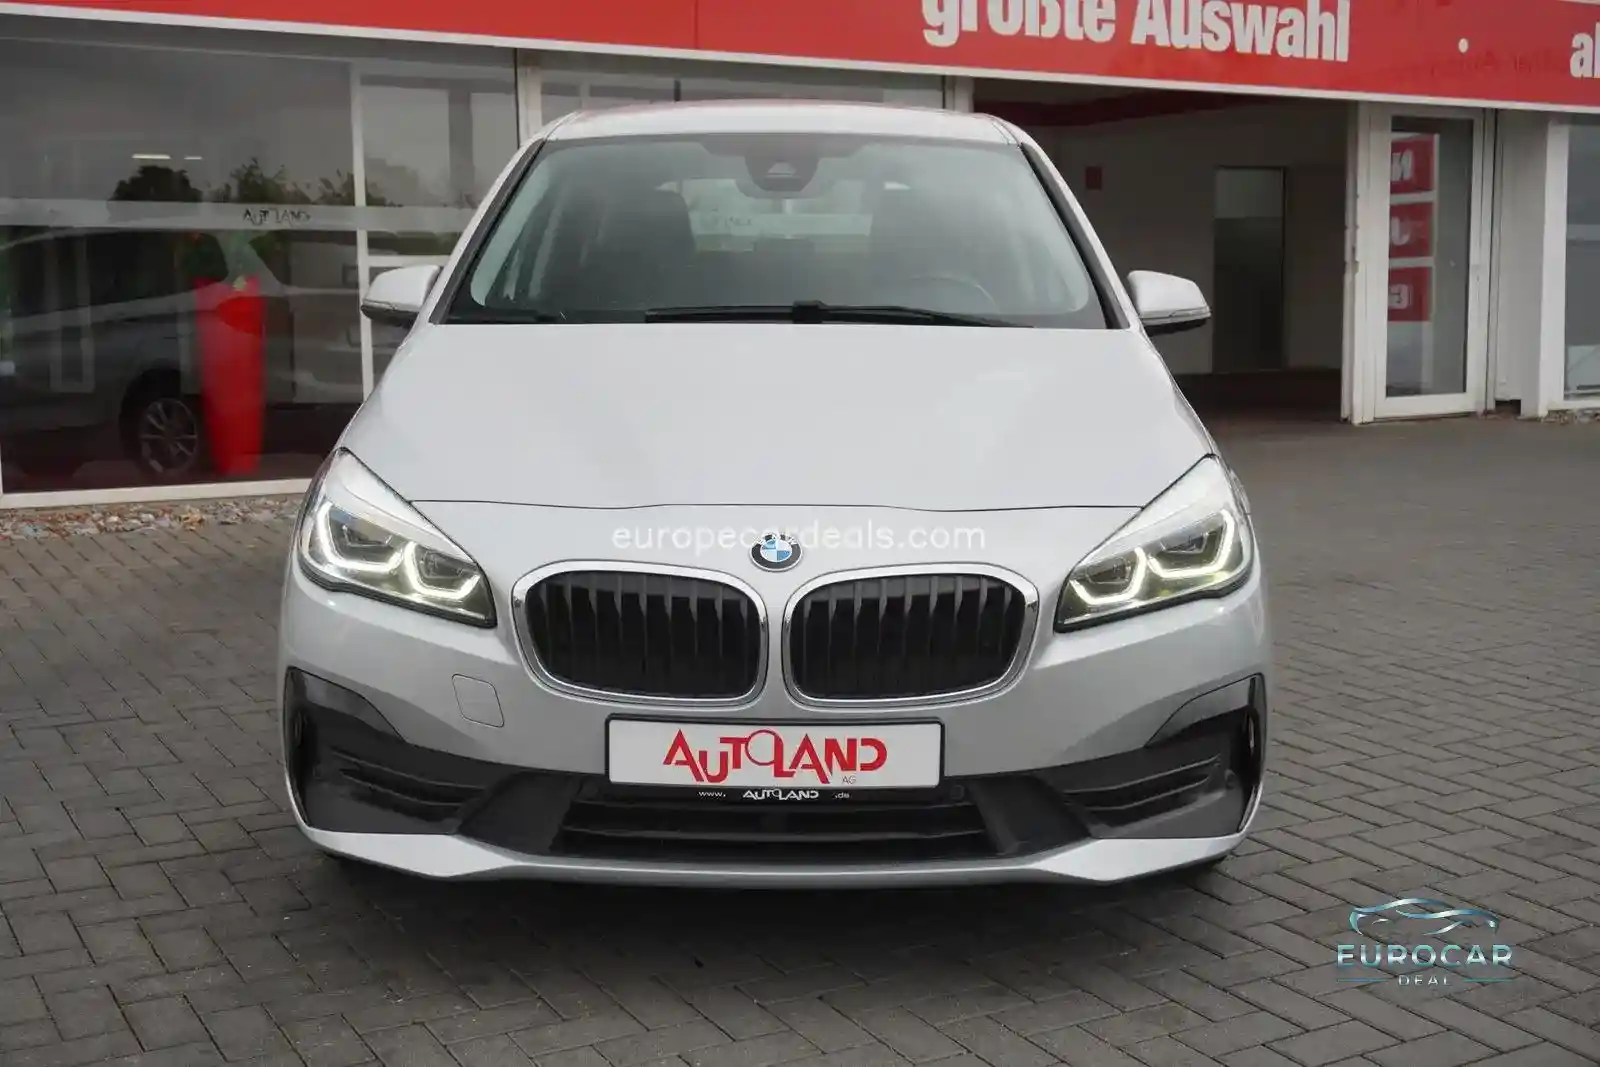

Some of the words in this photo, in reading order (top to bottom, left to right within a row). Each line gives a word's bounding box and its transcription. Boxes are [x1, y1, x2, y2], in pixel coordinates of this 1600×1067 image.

[1130, 0, 1350, 62] Auswahl
[663, 729, 888, 785] AUTOLAND
[698, 790, 726, 798] www.
[842, 775, 857, 785] AG
